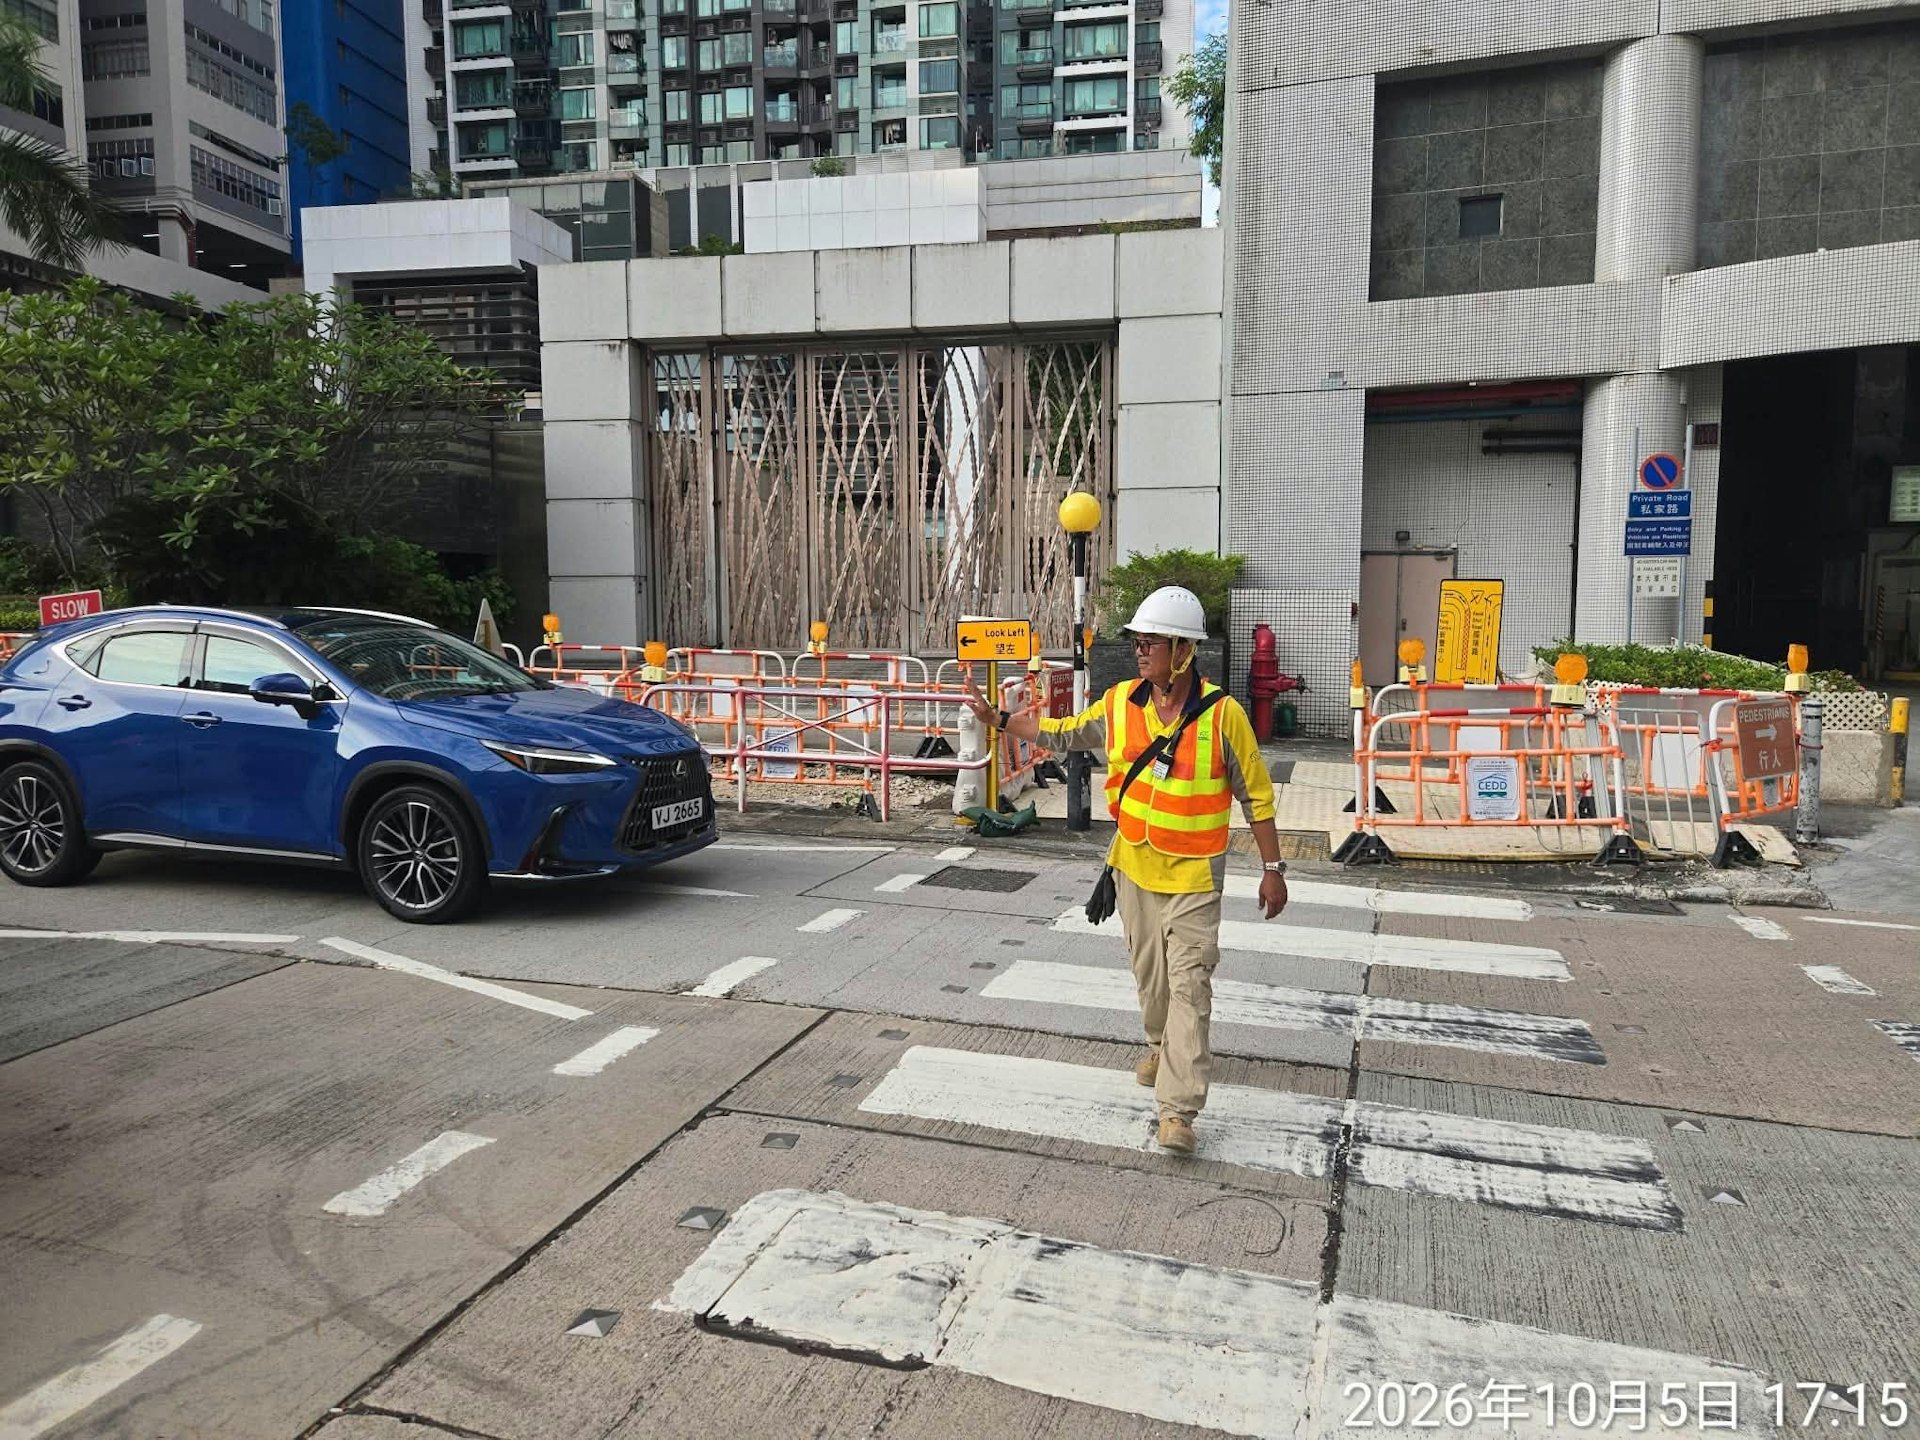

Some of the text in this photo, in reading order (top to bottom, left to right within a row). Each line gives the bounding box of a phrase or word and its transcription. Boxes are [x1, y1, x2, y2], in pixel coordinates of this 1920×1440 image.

[1640, 503, 1679, 514] 私家路
[51, 598, 88, 620] SLOW
[985, 628, 1024, 637] Look Left
[995, 643, 1016, 655] 望左
[1738, 706, 1790, 723] PEDESTRIANS
[1758, 748, 1782, 770] 行人
[1478, 781, 1508, 790] CEDD
[655, 800, 700, 825] VJ 2665
